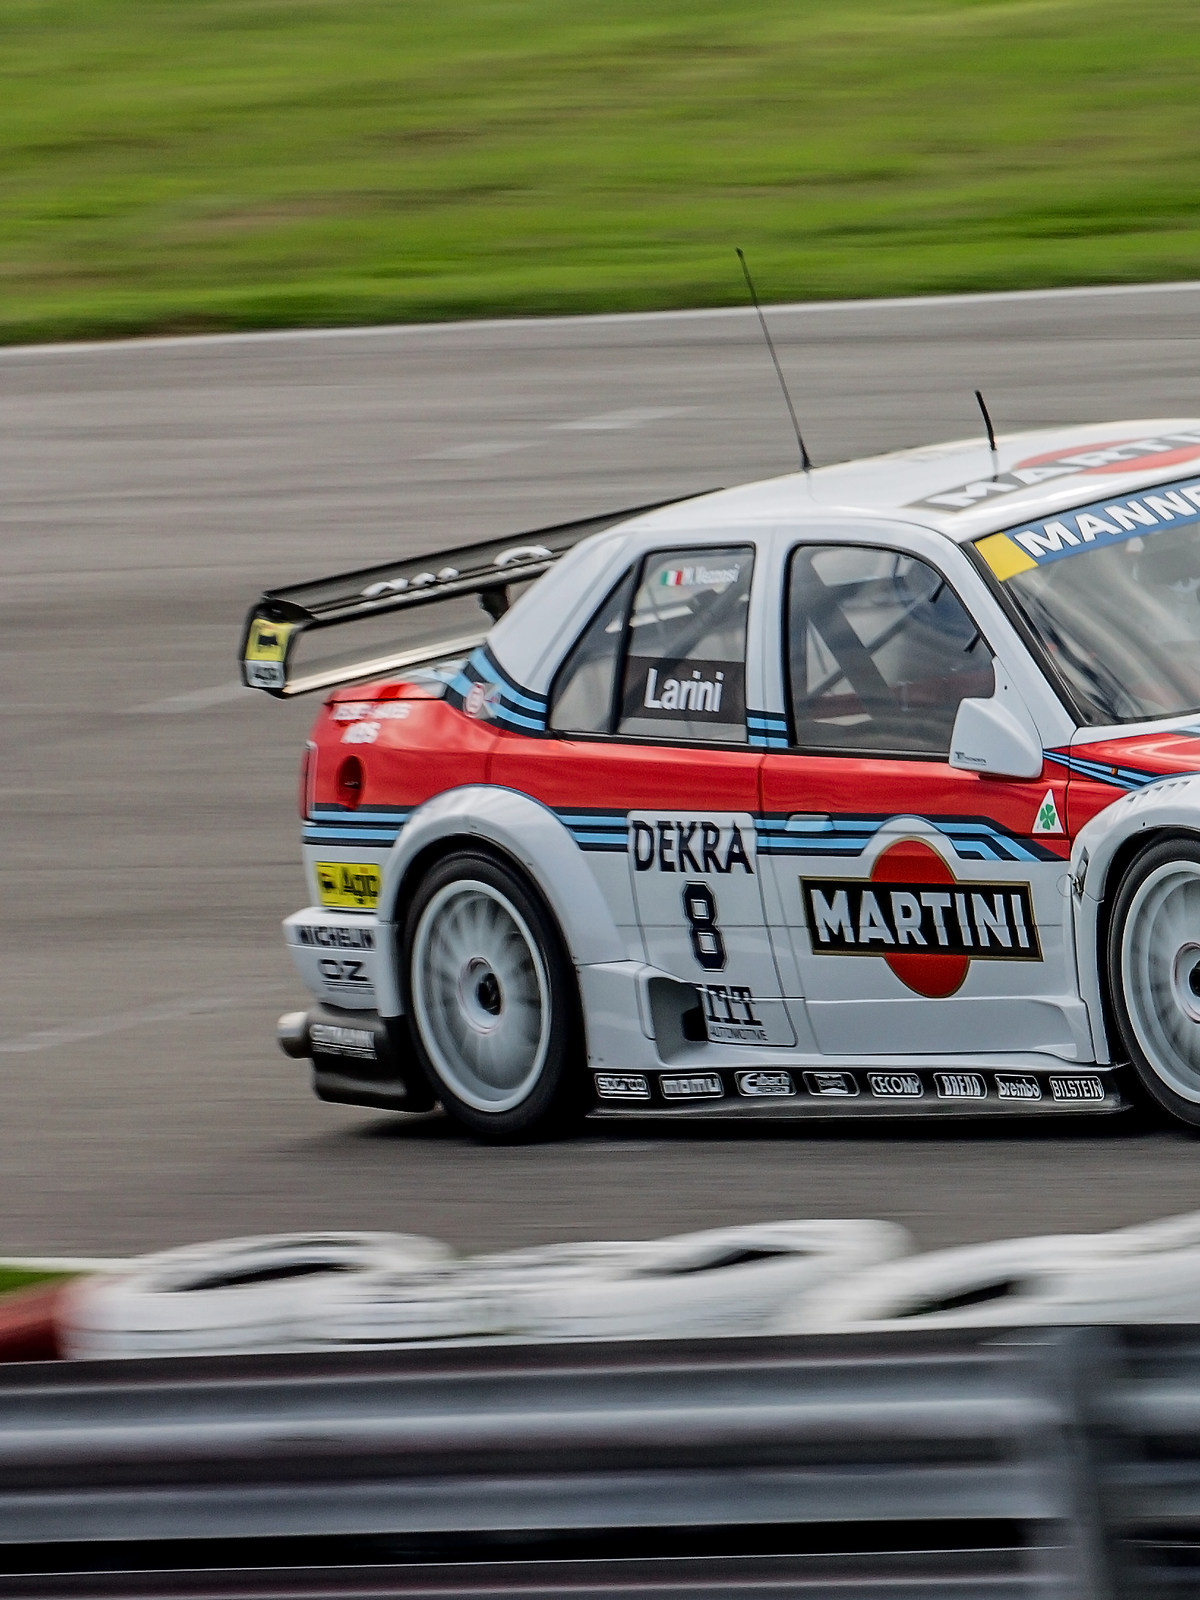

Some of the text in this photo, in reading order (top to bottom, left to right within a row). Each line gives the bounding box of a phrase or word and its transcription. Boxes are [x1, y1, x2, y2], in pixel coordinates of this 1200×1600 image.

[643, 667, 725, 713] Larini
[631, 819, 755, 874] DEKRA
[681, 880, 728, 972] 8
[810, 889, 1030, 949] MARTINI
[997, 1077, 1041, 1098] brembo
[1050, 1079, 1104, 1099] BILSTEIN
